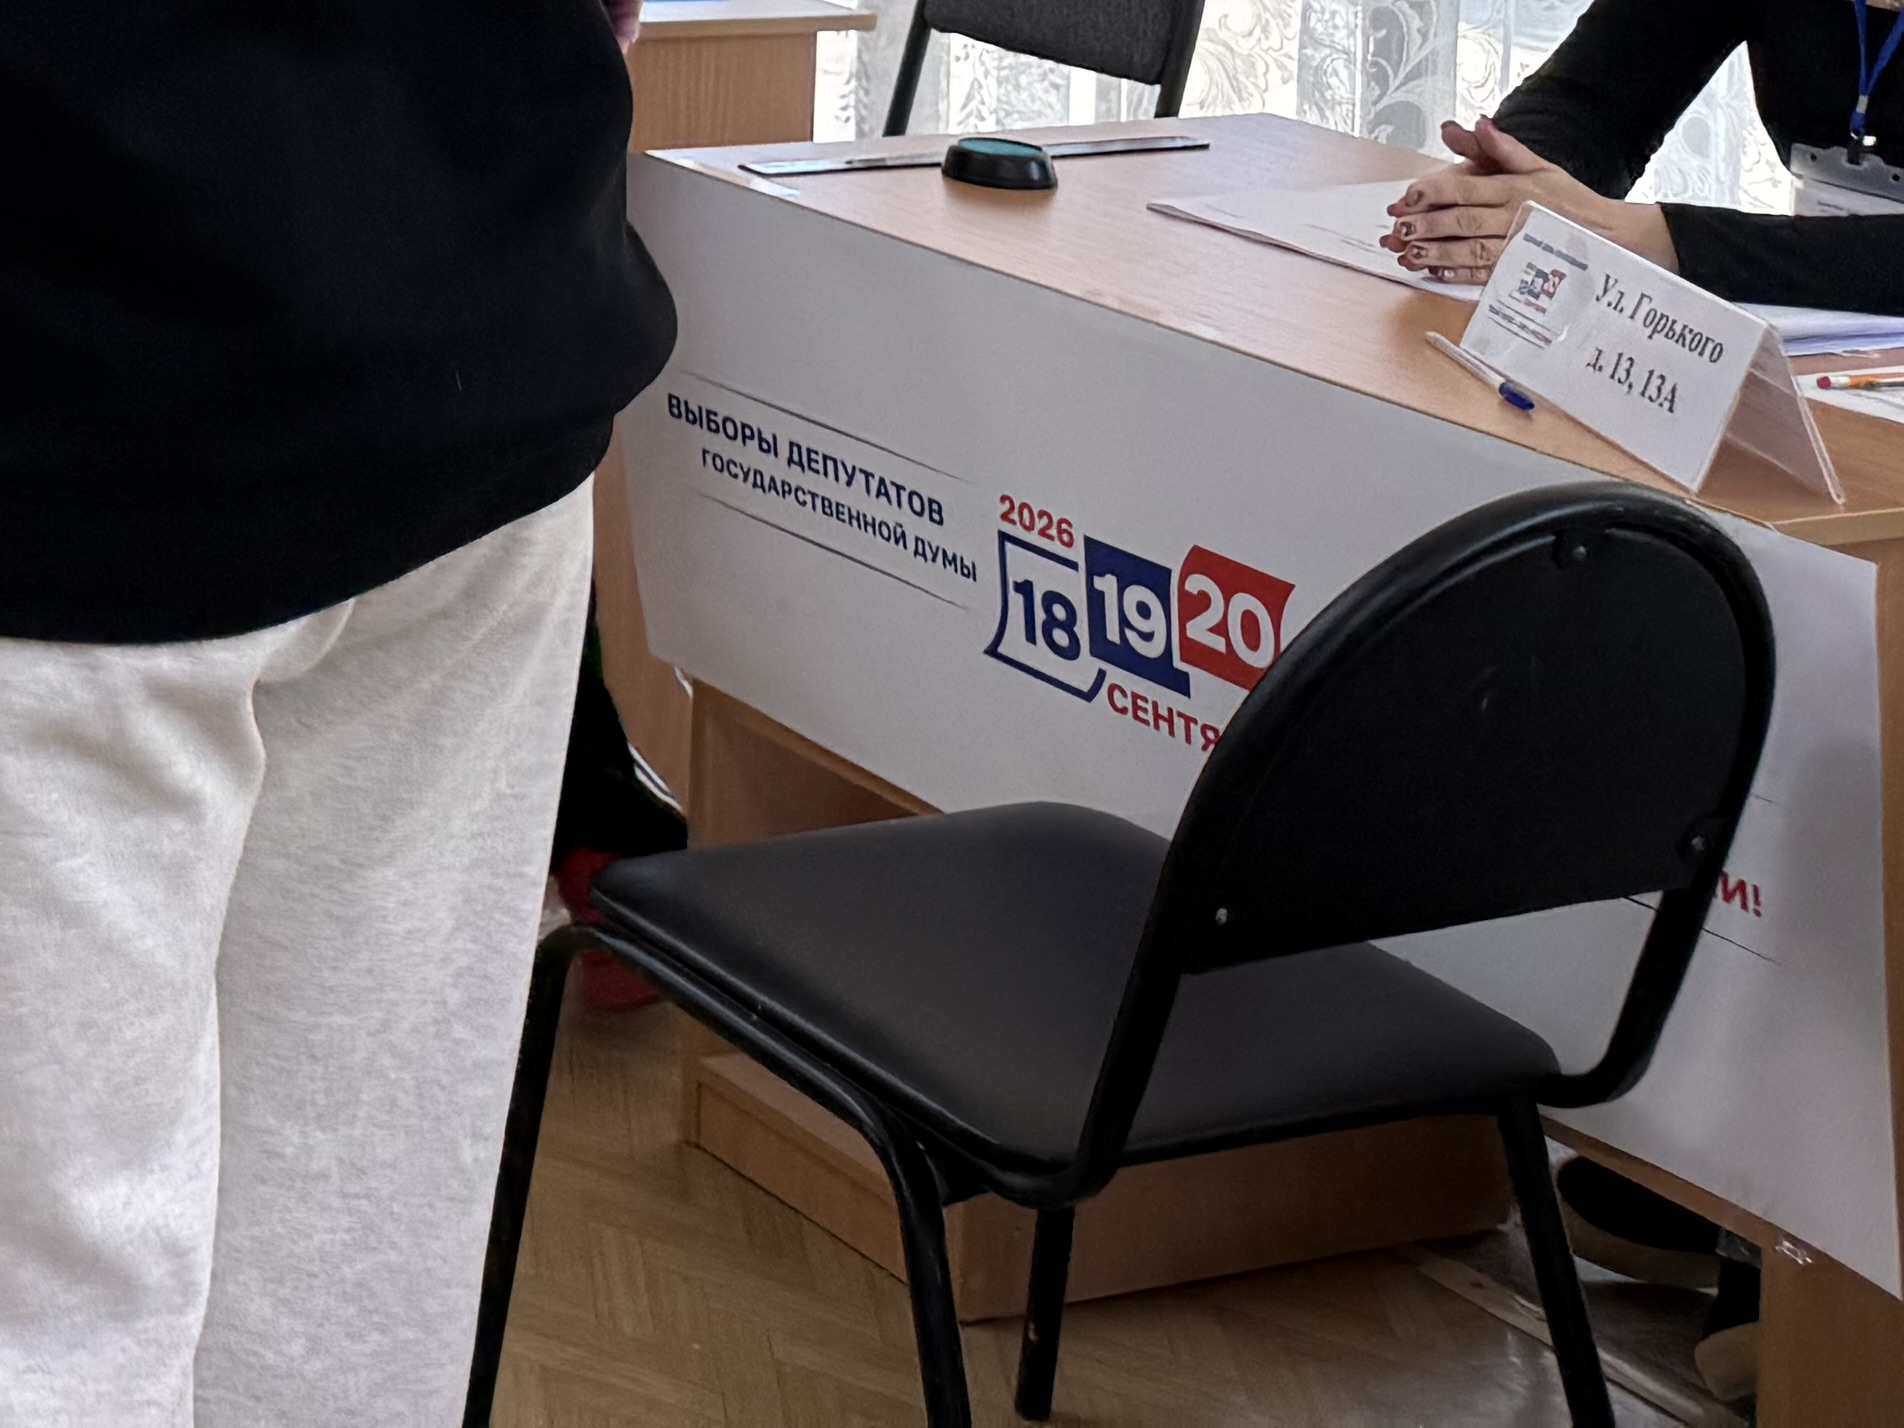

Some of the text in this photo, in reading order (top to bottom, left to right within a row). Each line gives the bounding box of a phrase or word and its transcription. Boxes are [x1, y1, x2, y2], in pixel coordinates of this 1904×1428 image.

[1594, 273, 1625, 314] Ул.
[1628, 292, 1725, 364] Горького
[1586, 346, 1679, 415] д. 13, 13А
[667, 392, 945, 526] ВЫБОРЫ ДЕПУТАТОВ
[701, 448, 978, 583] ГОСУДАРСТВЕННОЙ ДУМЫ
[999, 494, 1075, 548] 2026
[1012, 573, 1276, 669] 18 19 20
[1107, 682, 1221, 752] СЕНТЯ
